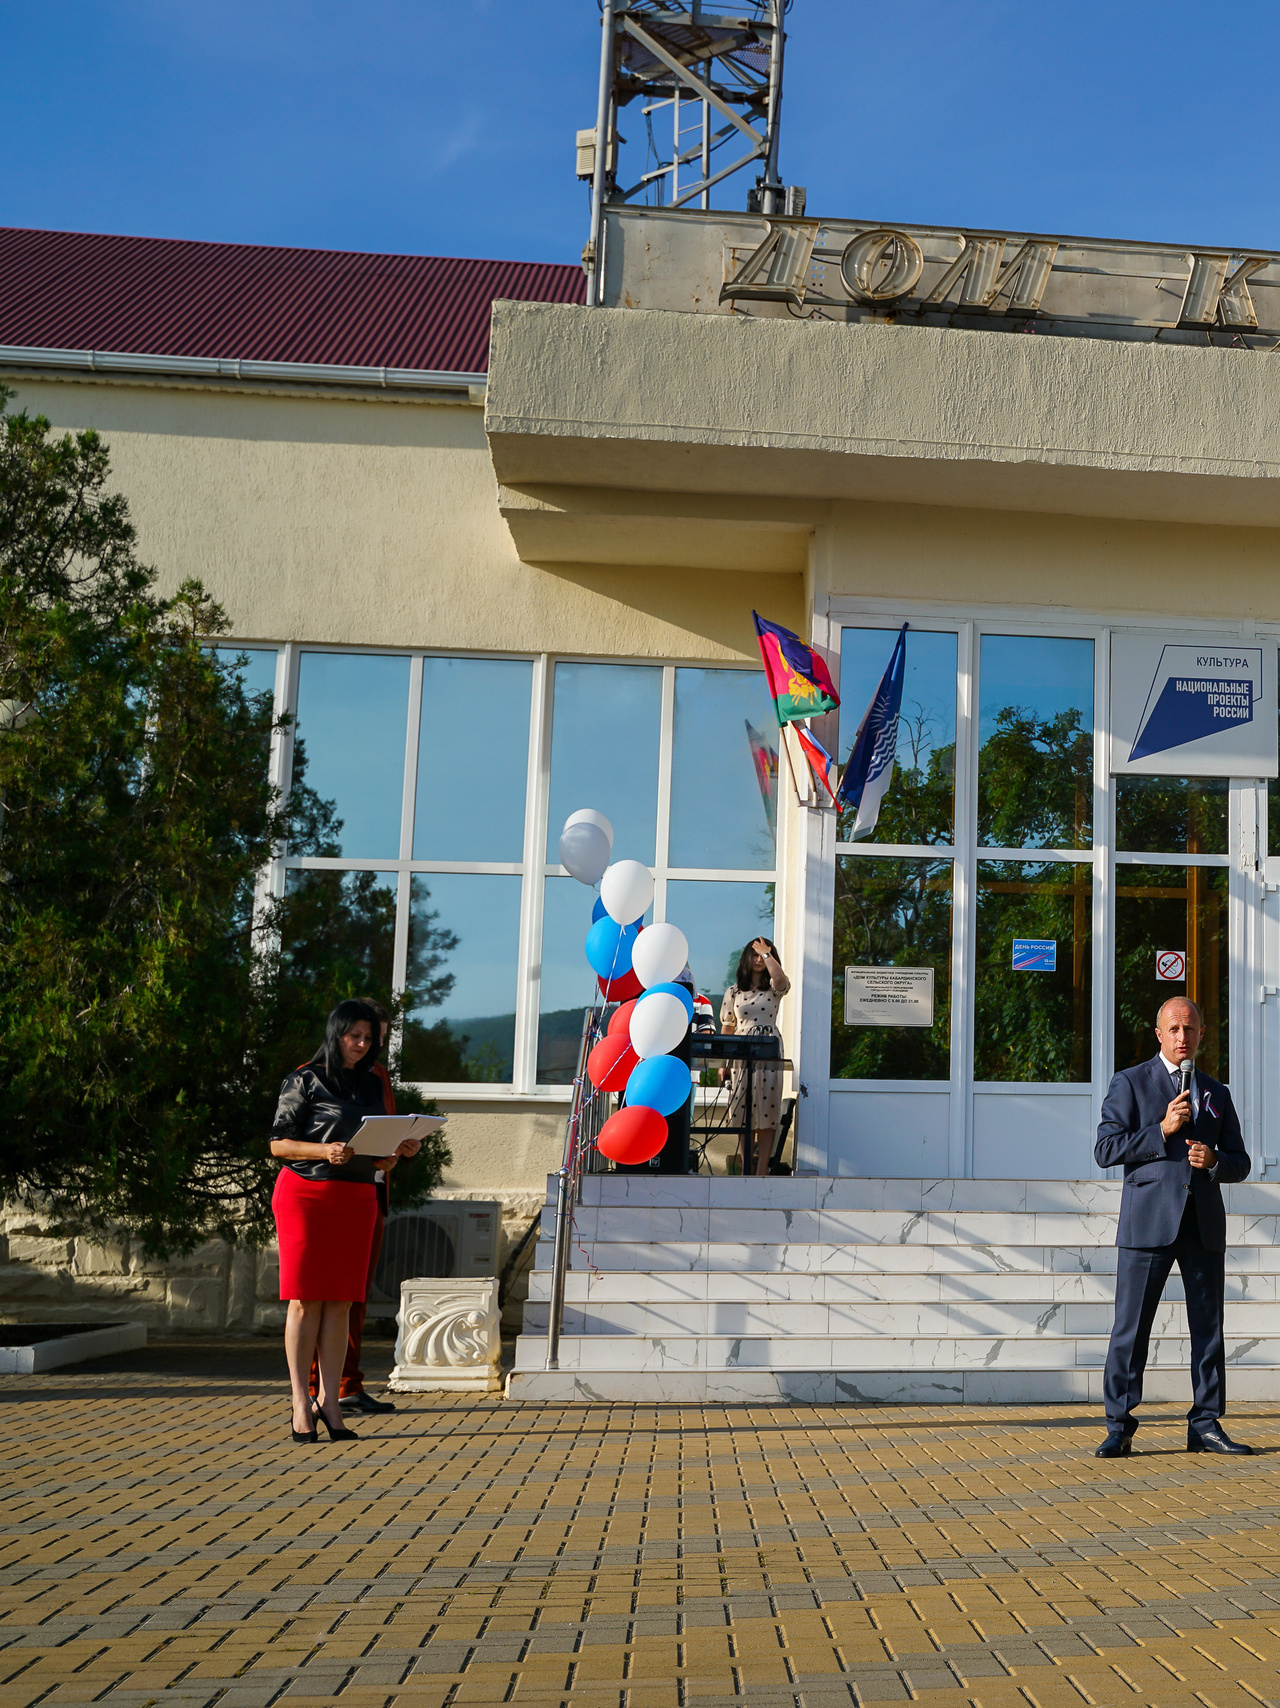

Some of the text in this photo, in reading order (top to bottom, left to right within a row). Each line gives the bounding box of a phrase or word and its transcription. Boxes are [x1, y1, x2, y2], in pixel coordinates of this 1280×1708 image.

[719, 219, 1059, 317] ДОМ
[1196, 656, 1249, 668] КУЛЬТУРА
[1175, 680, 1250, 694] НАЦИОНАЛЬНЫЕ
[1207, 693, 1249, 706] ПРОЕКТЫ
[1213, 706, 1249, 718] РОССИИ
